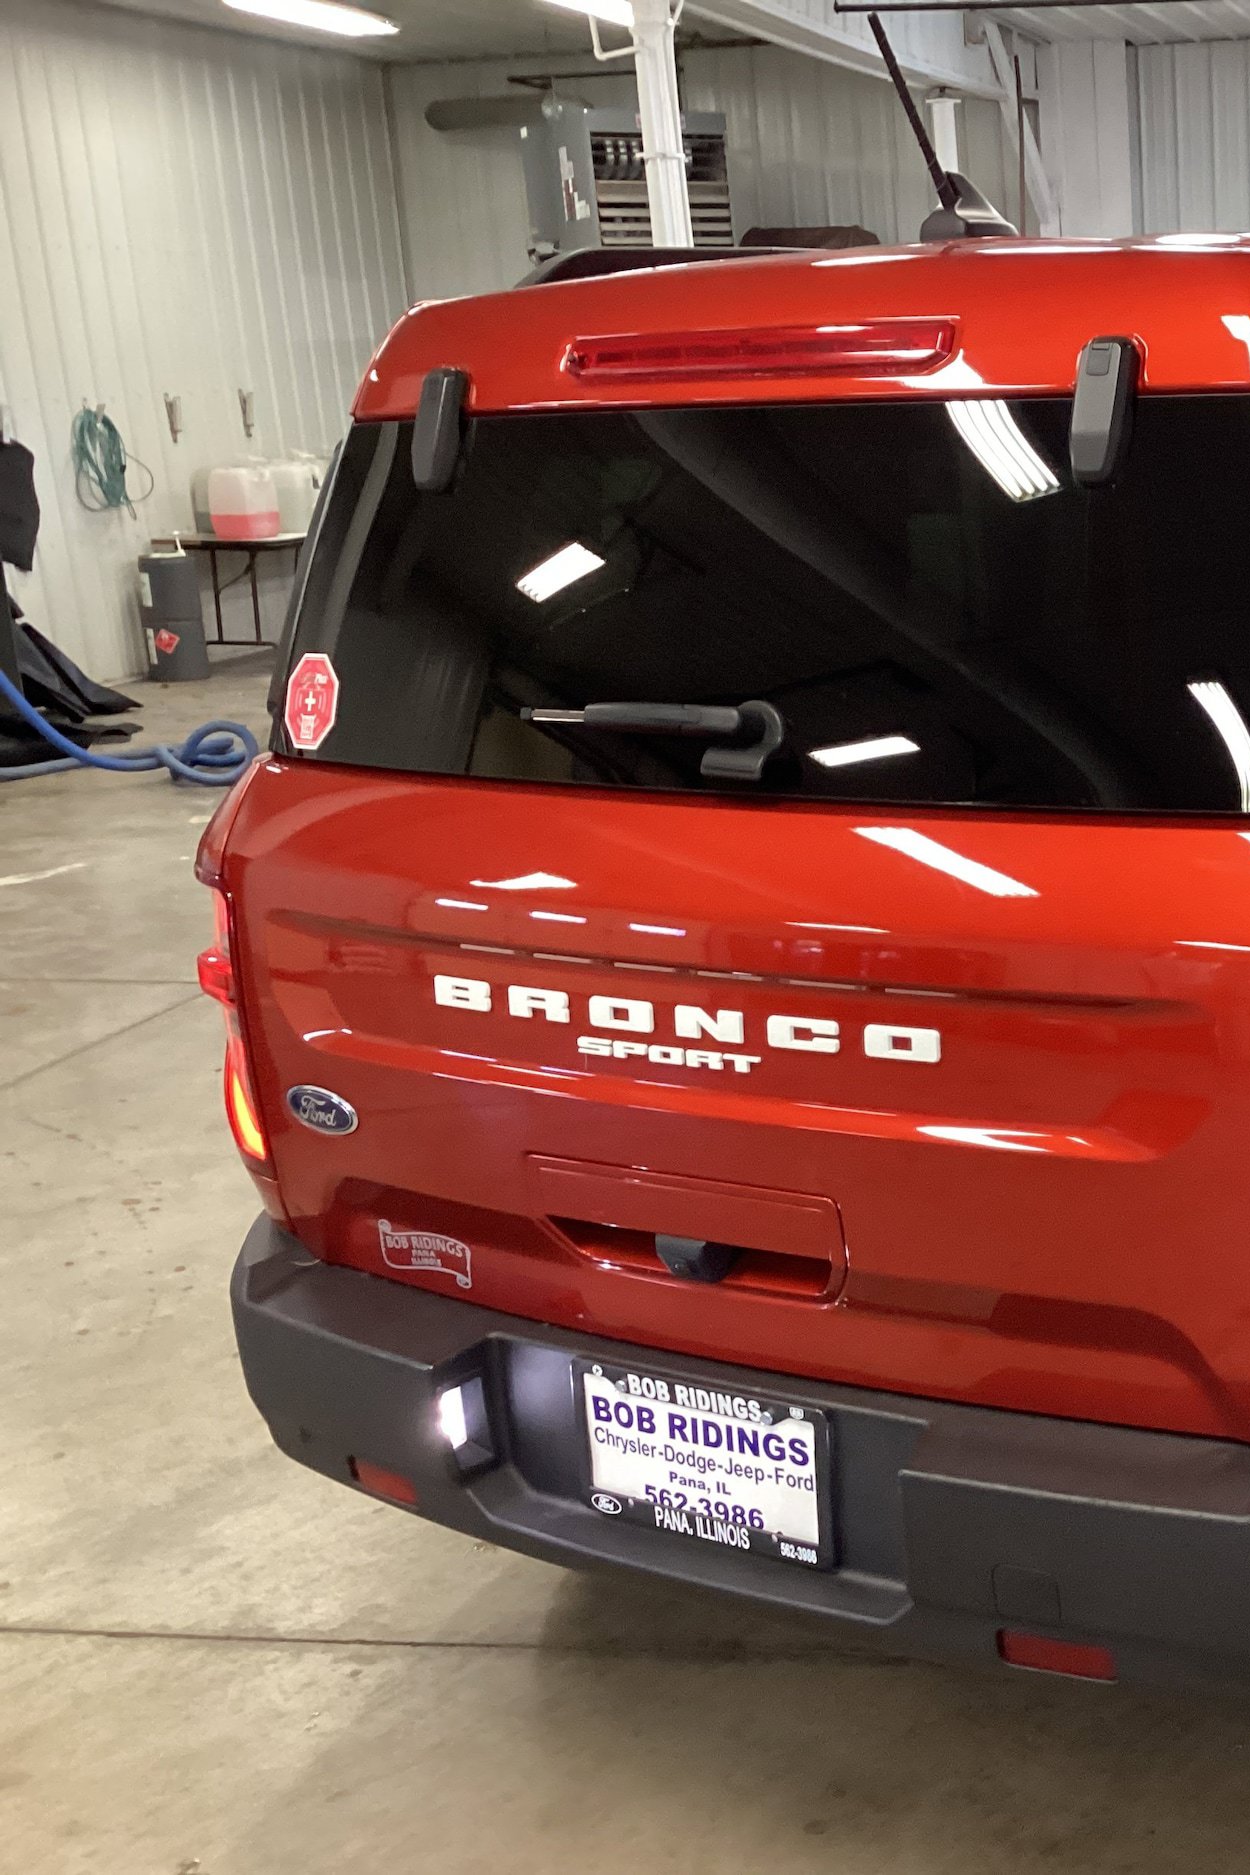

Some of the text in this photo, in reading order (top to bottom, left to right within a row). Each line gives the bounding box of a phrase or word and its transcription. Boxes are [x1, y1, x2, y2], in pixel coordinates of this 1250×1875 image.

[433, 974, 942, 1063] BRONCO
[577, 1036, 762, 1073] SPORT
[300, 1095, 338, 1127] Ford
[385, 1235, 463, 1258] BOB RIDINGS
[626, 1374, 671, 1402] BOB
[675, 1384, 762, 1422] RIDINGS
[592, 1395, 810, 1467] BOB RIDINGS
[594, 1426, 815, 1492] Chrysler-Dodge-Jeep-Ford
[669, 1471, 732, 1496] Pana, IL
[644, 1484, 765, 1530] 562-3986
[695, 1516, 751, 1550] ILLINOIS
